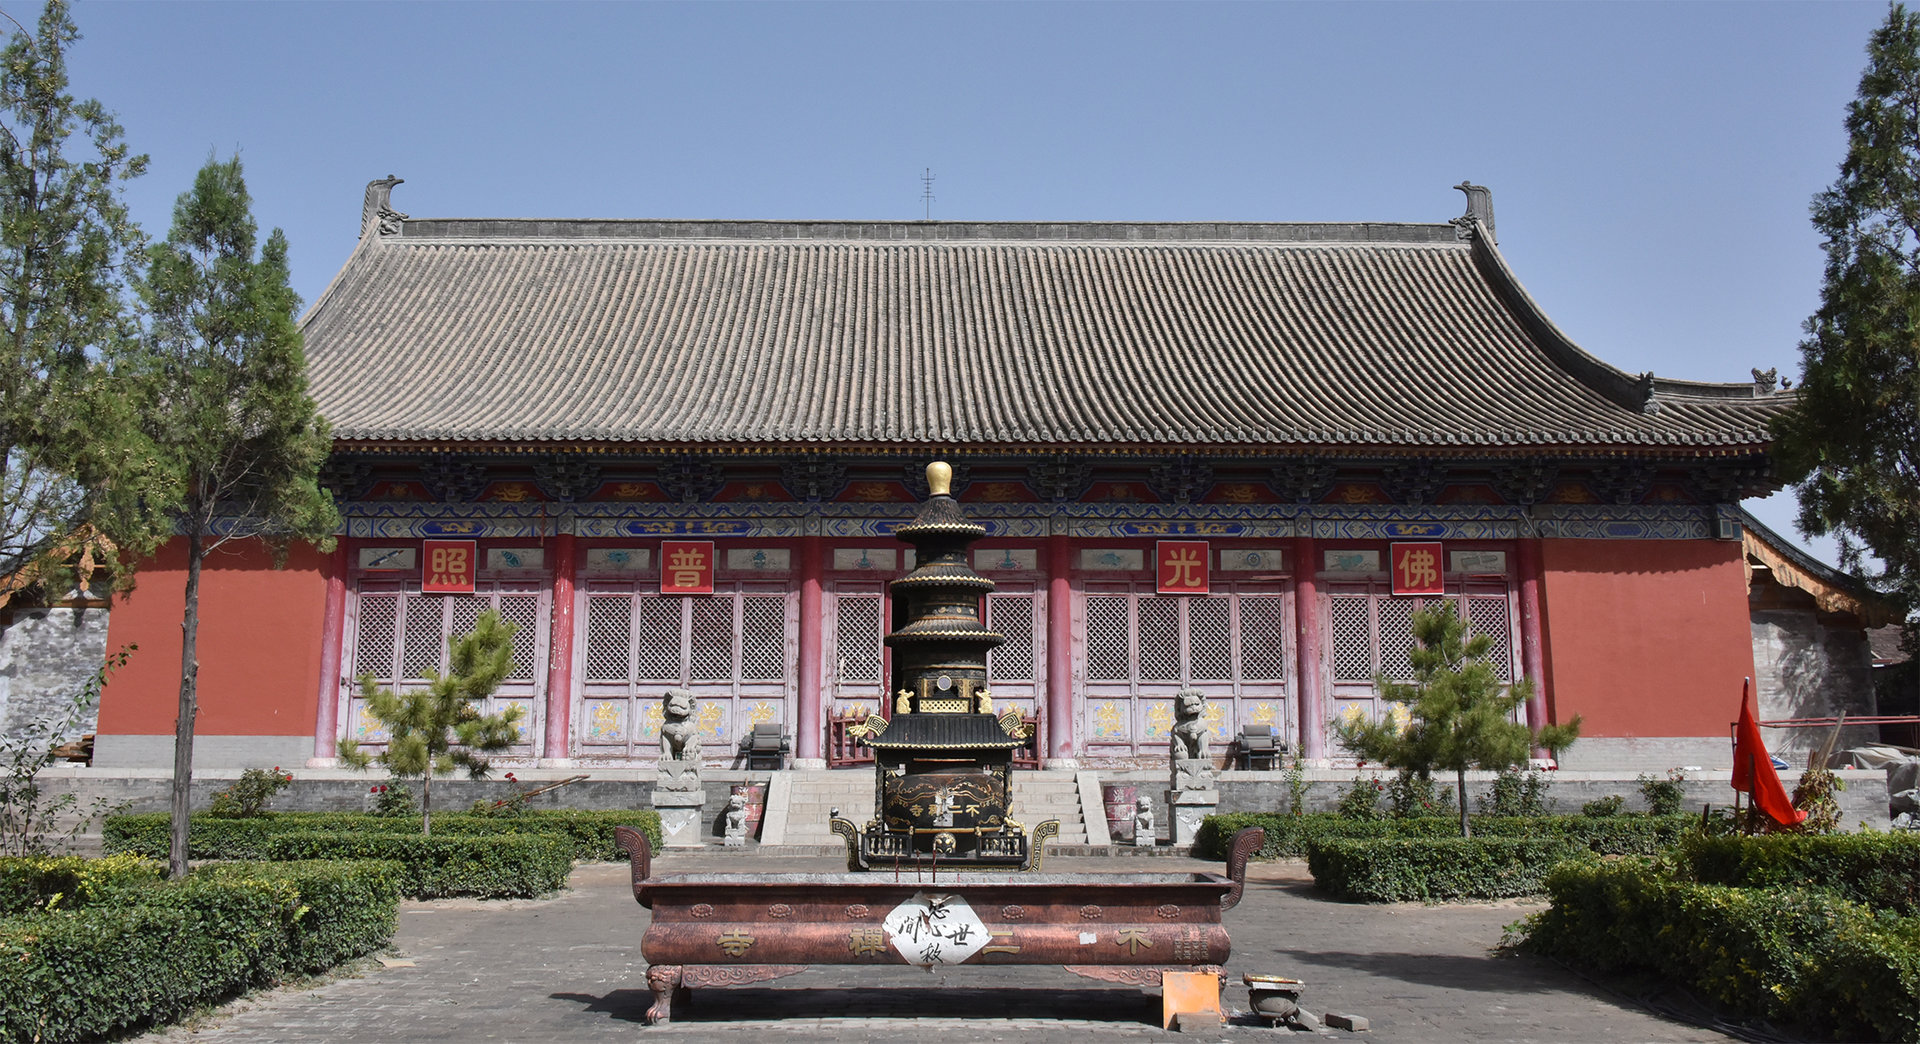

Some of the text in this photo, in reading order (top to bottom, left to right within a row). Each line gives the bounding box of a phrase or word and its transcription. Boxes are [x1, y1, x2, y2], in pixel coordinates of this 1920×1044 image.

[430, 548, 468, 585] 照
[668, 548, 706, 587] 普
[1164, 548, 1202, 587] 光
[1398, 550, 1437, 588] 佛
[716, 928, 755, 957] 寺
[1116, 927, 1154, 956] 不
